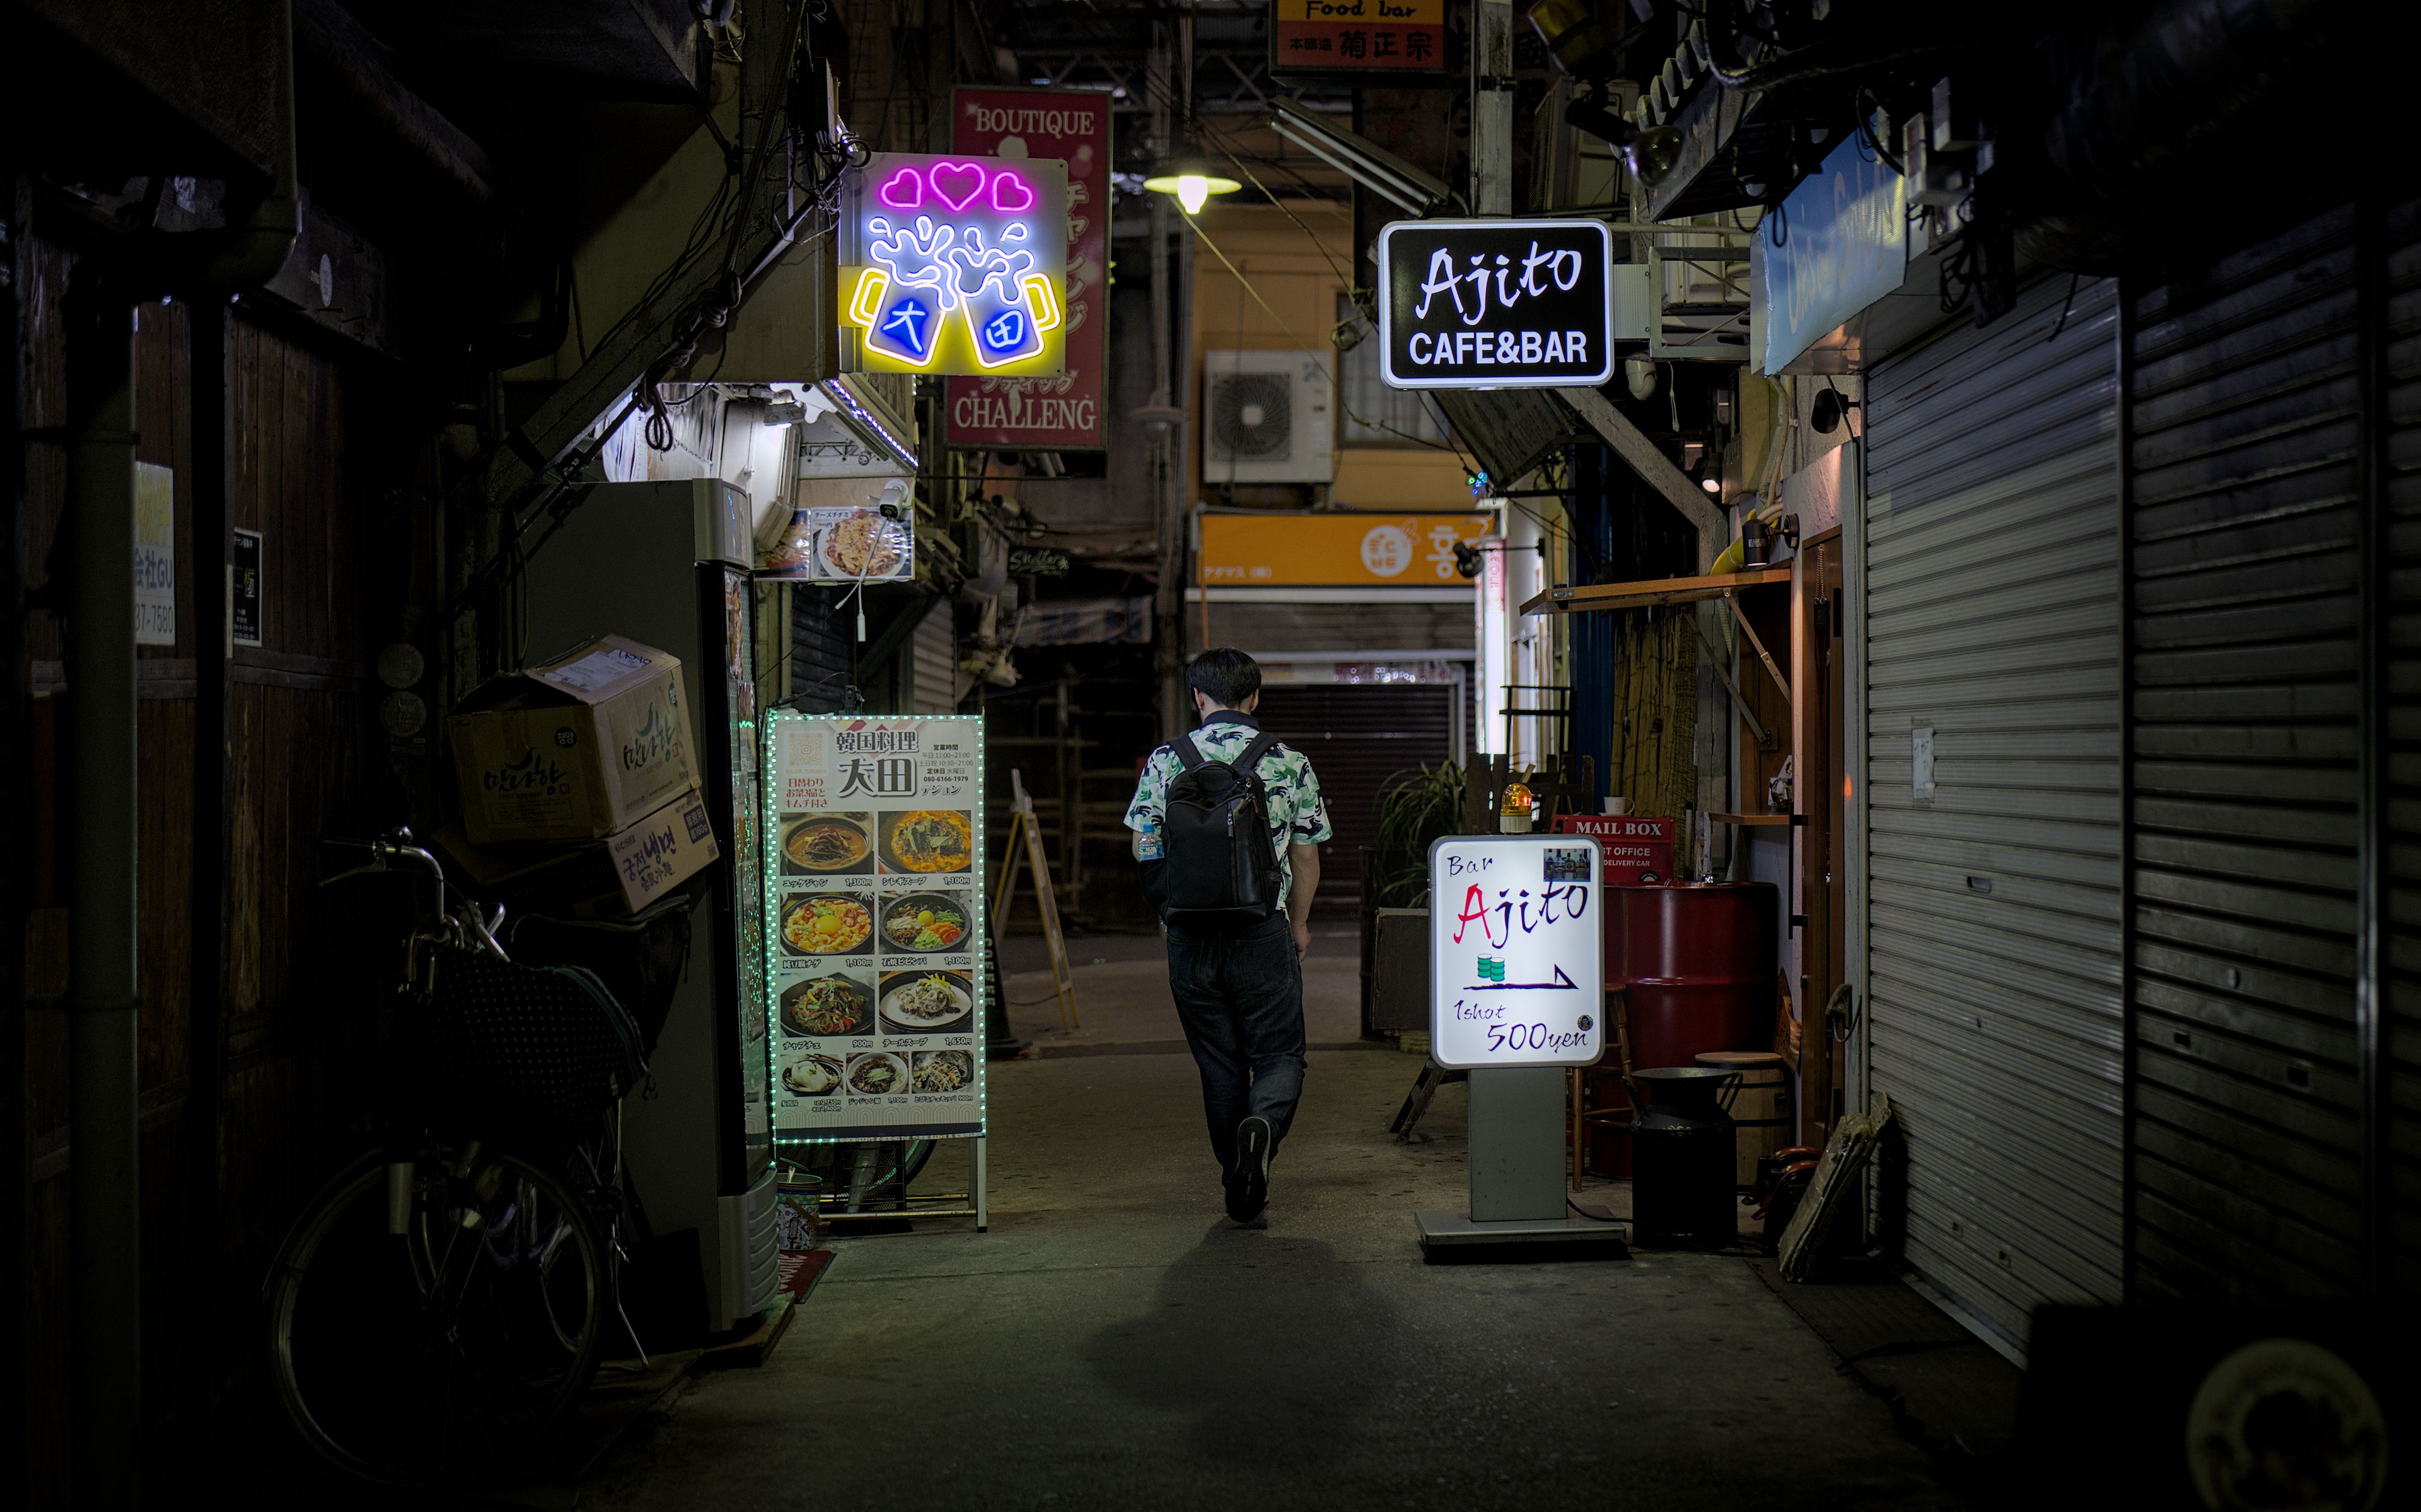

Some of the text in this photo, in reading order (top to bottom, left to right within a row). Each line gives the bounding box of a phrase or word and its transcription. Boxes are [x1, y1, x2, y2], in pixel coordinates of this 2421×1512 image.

[1306, 1, 1417, 20] Food bar
[1338, 30, 1432, 62] 菊正宗
[975, 108, 1095, 135] BOUTIQUE
[1414, 239, 1583, 326] Ajito
[881, 299, 1025, 354] 大 田
[1408, 330, 1588, 366] CAFE&BAR
[955, 397, 1097, 430] CHALLENG
[557, 730, 575, 744] 청양
[836, 731, 915, 751] 韓国料理
[789, 778, 824, 788] 日替わり
[838, 756, 916, 795] 大田
[786, 788, 826, 798] お菜3品と
[784, 799, 828, 808] キムチ付き
[1576, 821, 1662, 836] MAIL BOX
[1614, 847, 1651, 857] OFFICE
[1447, 855, 1493, 877] Bar
[782, 878, 873, 888] ユッケジャン 1,300円
[944, 876, 970, 885] 1,100円
[1453, 881, 1588, 949] Ajito
[845, 959, 873, 967] 1,100円
[944, 956, 972, 965] 1,100円
[1453, 1000, 1507, 1020] 1shot
[852, 1039, 873, 1047] 900円
[945, 1037, 972, 1046] 1,650円
[1487, 1022, 1588, 1053] 500yen
